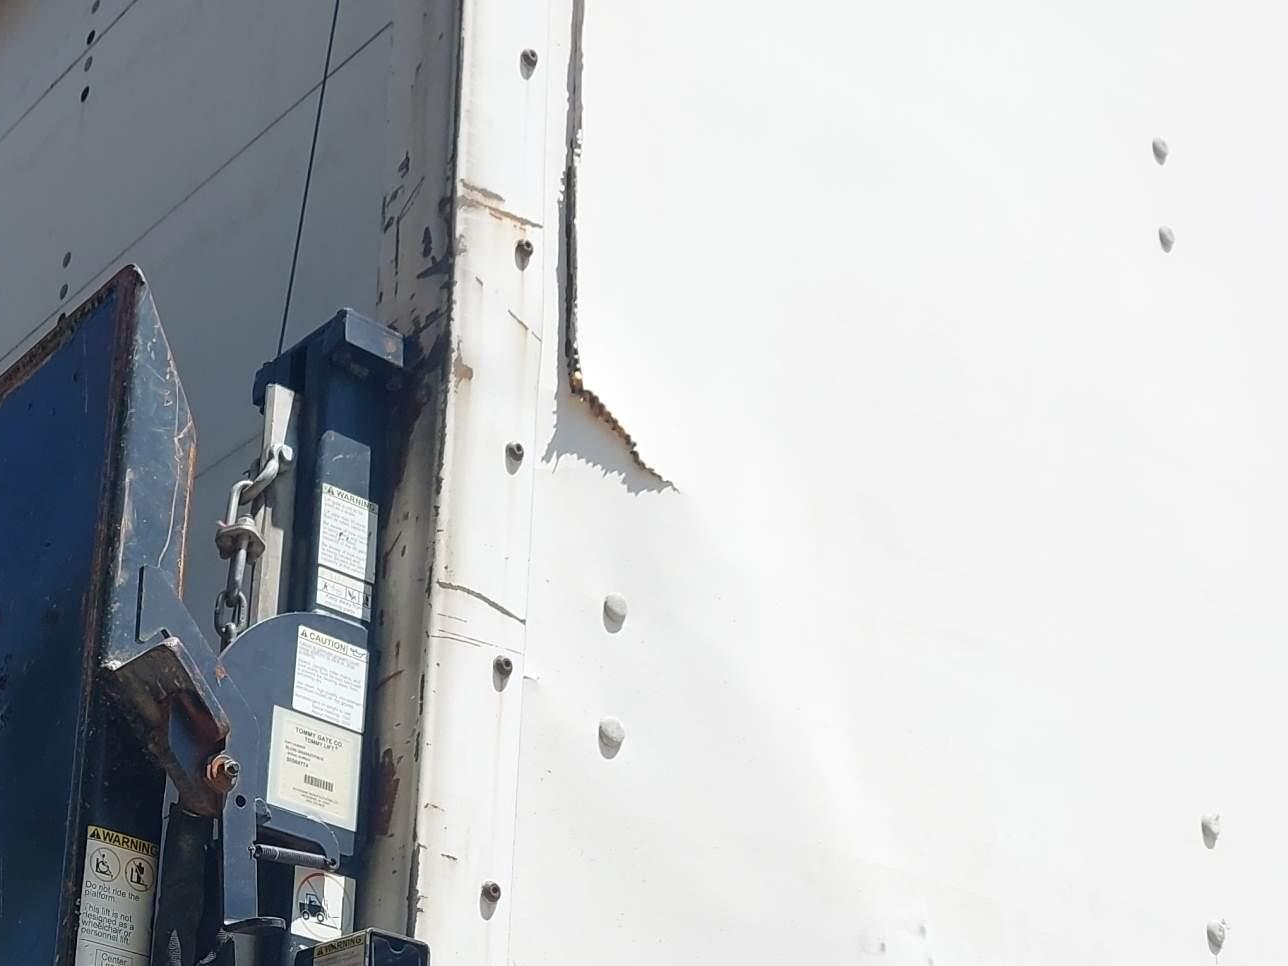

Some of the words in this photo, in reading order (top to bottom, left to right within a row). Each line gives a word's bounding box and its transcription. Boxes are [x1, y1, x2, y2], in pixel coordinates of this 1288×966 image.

[309, 632, 347, 652] CAUTION
[295, 726, 316, 739] TOMMY
[317, 733, 333, 744] GATE
[304, 736, 323, 747] TOMMY
[102, 830, 159, 857] WARNING
[85, 880, 97, 889] Do
[98, 884, 111, 893] not
[112, 887, 127, 898] ride
[128, 892, 140, 902] the
[82, 910, 117, 926] designed
[118, 921, 128, 929] as
[101, 906, 111, 916] lift
[120, 912, 132, 923] not
[80, 927, 118, 942] personnel
[81, 919, 123, 934] wheelchair
[101, 952, 128, 966] Center
